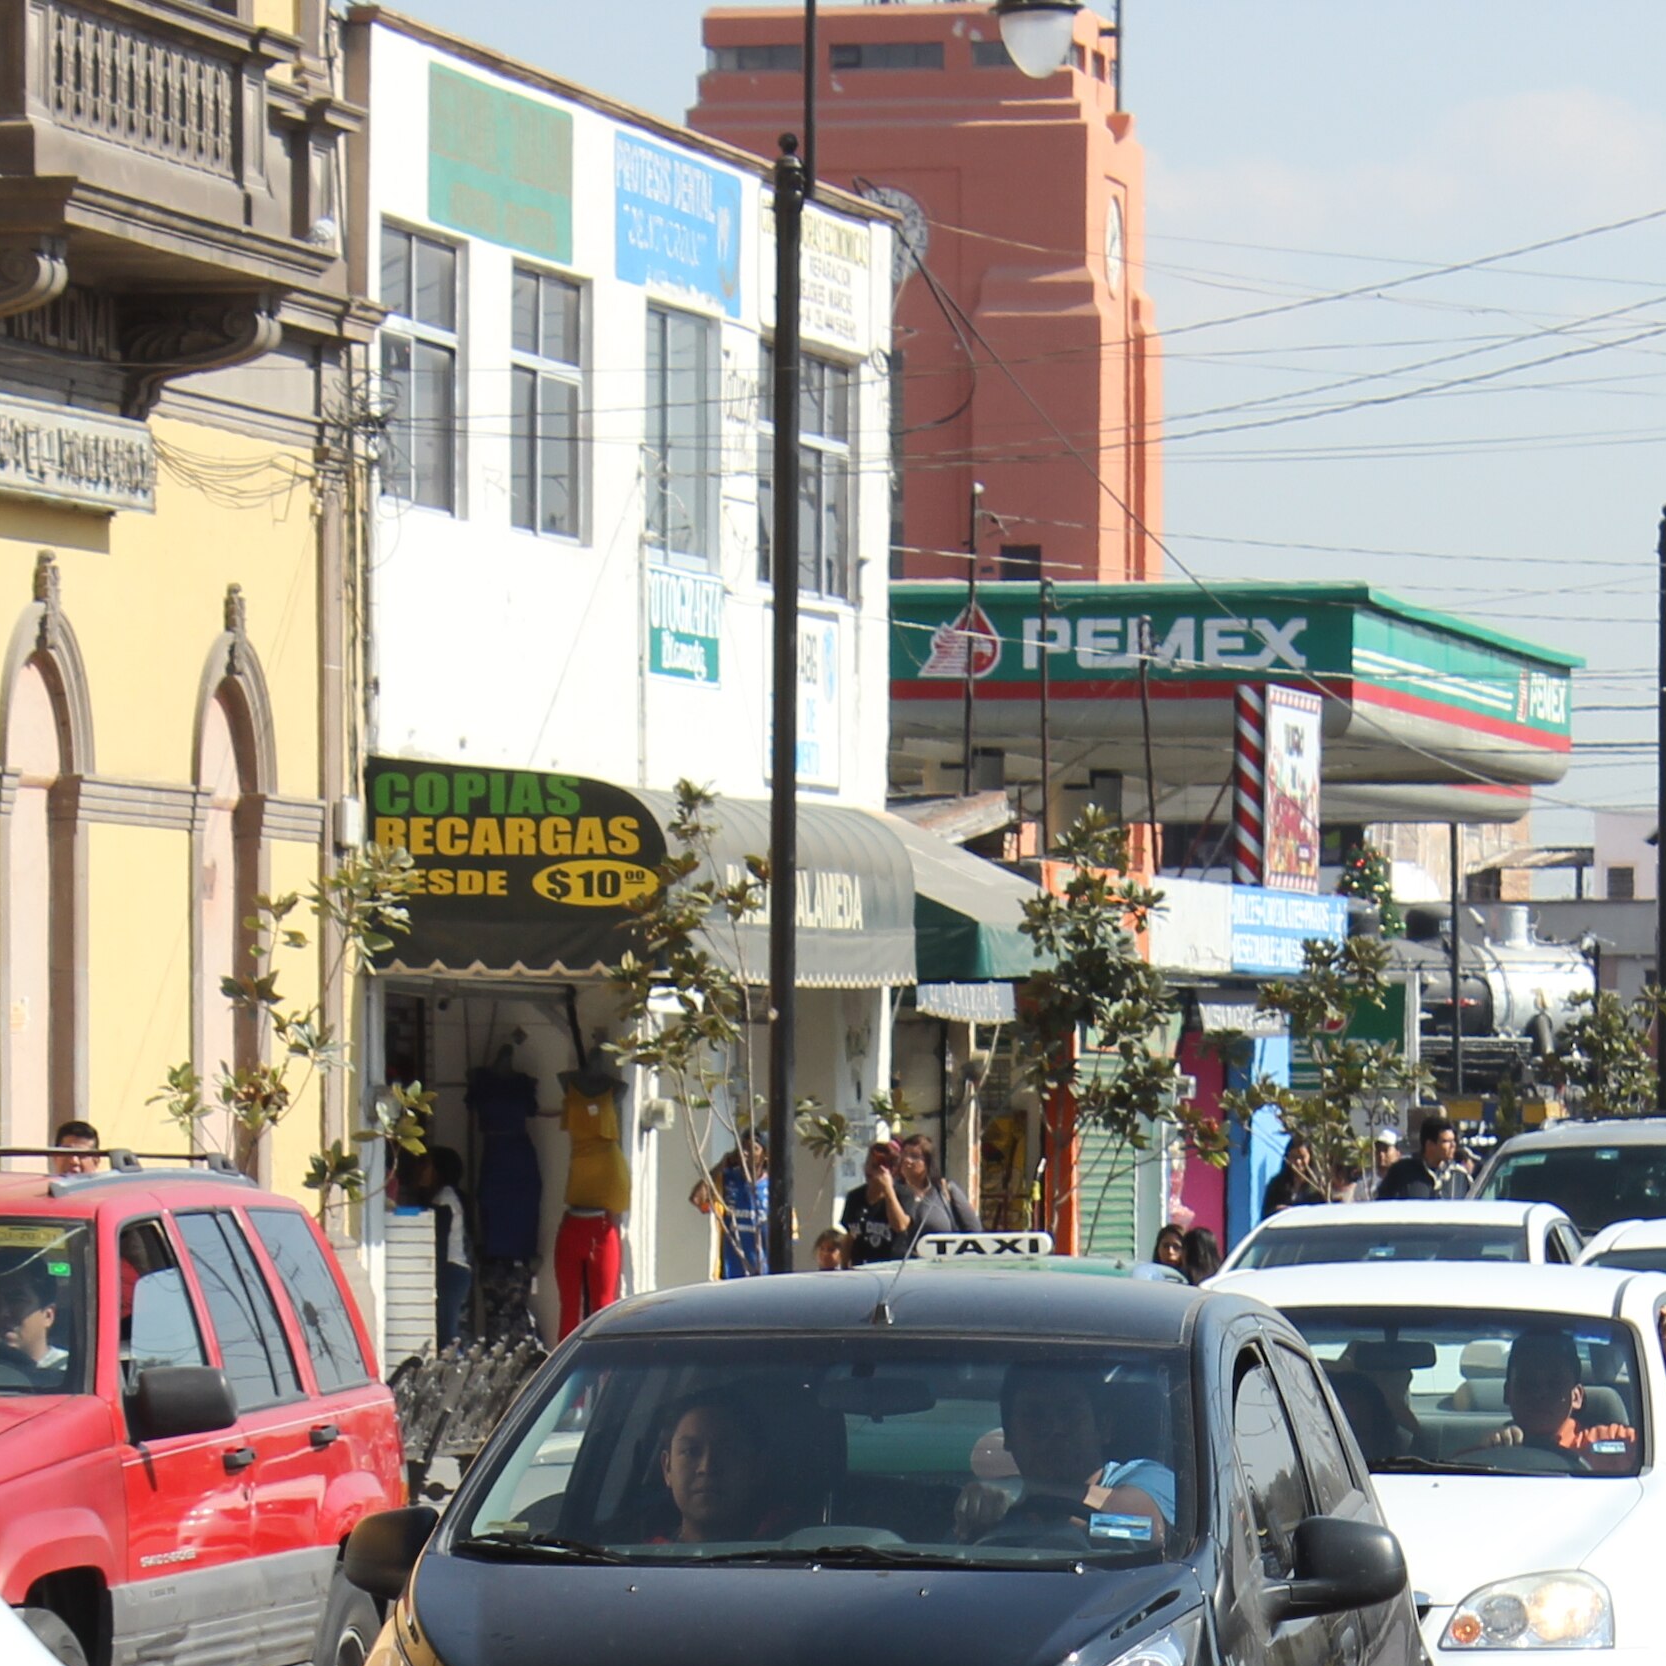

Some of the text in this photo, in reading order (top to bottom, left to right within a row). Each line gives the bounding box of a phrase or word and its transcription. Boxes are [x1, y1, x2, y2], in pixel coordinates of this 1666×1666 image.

[1022, 615, 1307, 670] PEMEX
[1530, 672, 1566, 725] PEMEX
[374, 771, 582, 815] COPIAS
[375, 815, 641, 857] RECARGAS
[376, 868, 508, 896] ESDE
[795, 868, 864, 931] ALAMEDA
[925, 1237, 1040, 1255] TAXI
